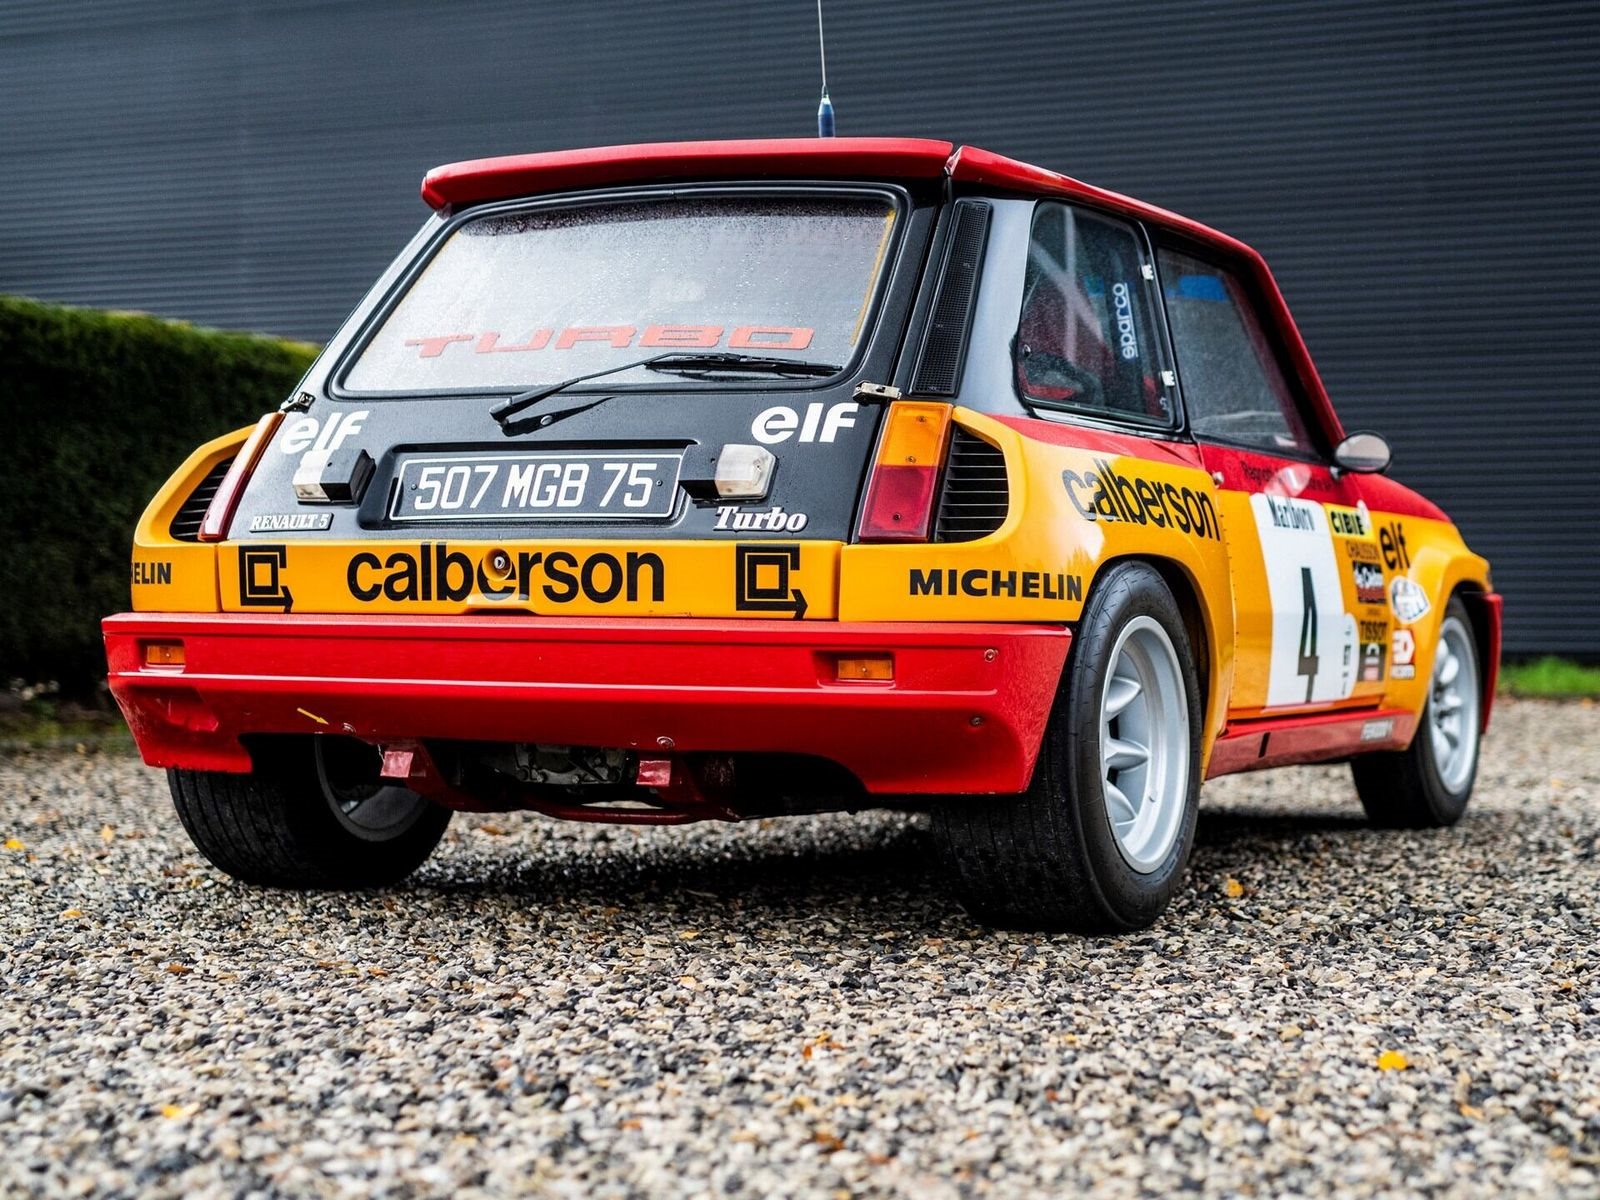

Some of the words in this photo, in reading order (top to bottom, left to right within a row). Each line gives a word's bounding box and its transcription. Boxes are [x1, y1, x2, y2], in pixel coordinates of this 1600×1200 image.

[404, 325, 815, 358] TURBO
[1112, 282, 1137, 360] sparco
[280, 410, 369, 453] elf
[751, 402, 859, 444] elf
[413, 465, 498, 511] 507
[501, 463, 589, 509] MGB
[599, 462, 658, 507] 75
[1061, 457, 1220, 541] calberson
[250, 514, 318, 530] RENAULT
[319, 514, 329, 529] 5
[713, 505, 808, 533] Turbo
[1379, 521, 1410, 571] elf
[131, 562, 172, 585] ELIN
[346, 541, 665, 603] calberson
[909, 568, 1082, 602] MICHELIN
[1297, 566, 1319, 704] 4
